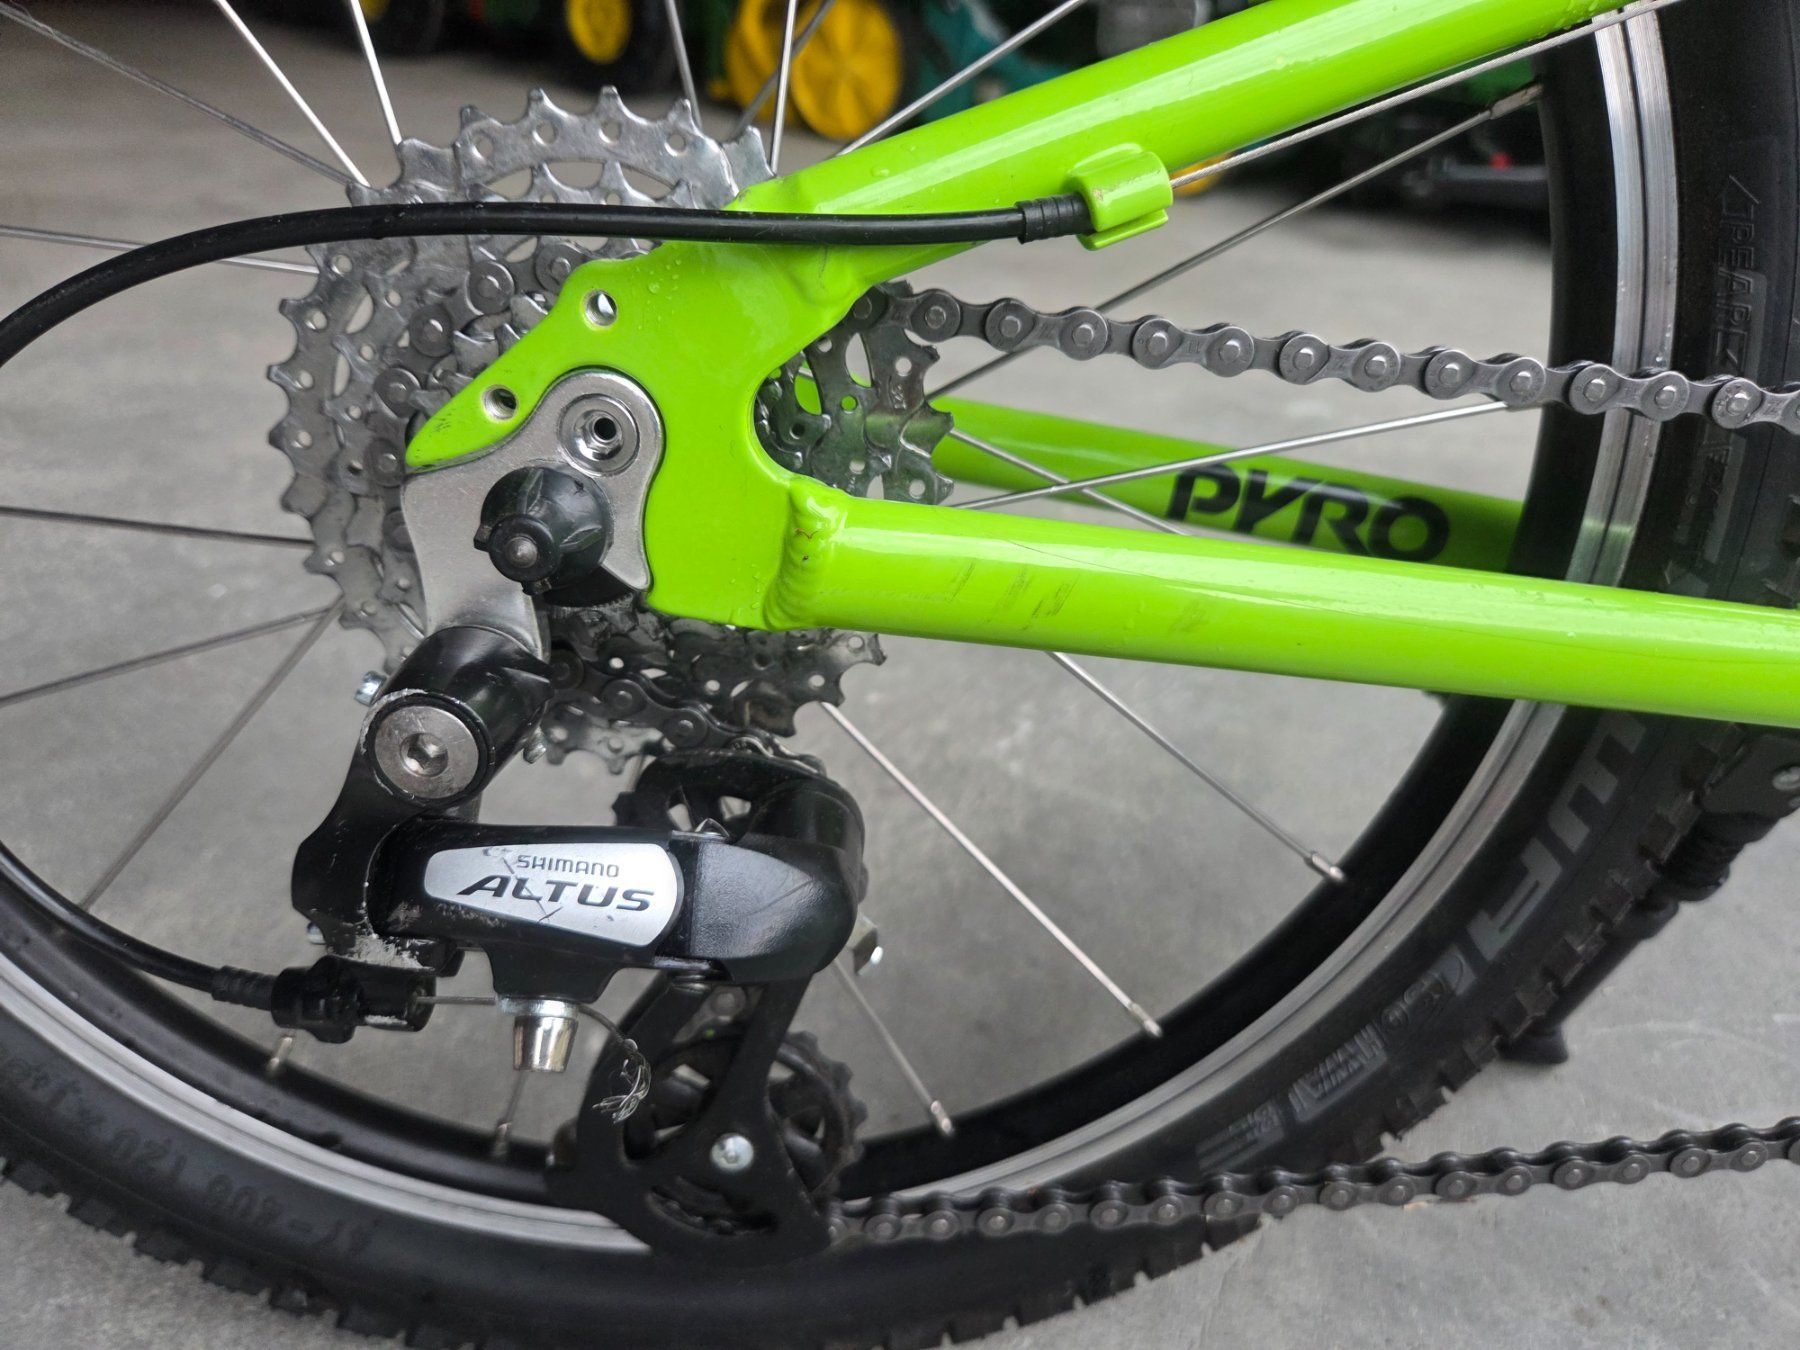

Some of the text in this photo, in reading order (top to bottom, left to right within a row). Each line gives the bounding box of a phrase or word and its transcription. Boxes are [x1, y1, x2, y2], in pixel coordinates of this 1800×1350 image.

[1166, 462, 1450, 562] PYRO
[516, 854, 620, 878] SHIMANO
[456, 875, 655, 912] ALTUS
